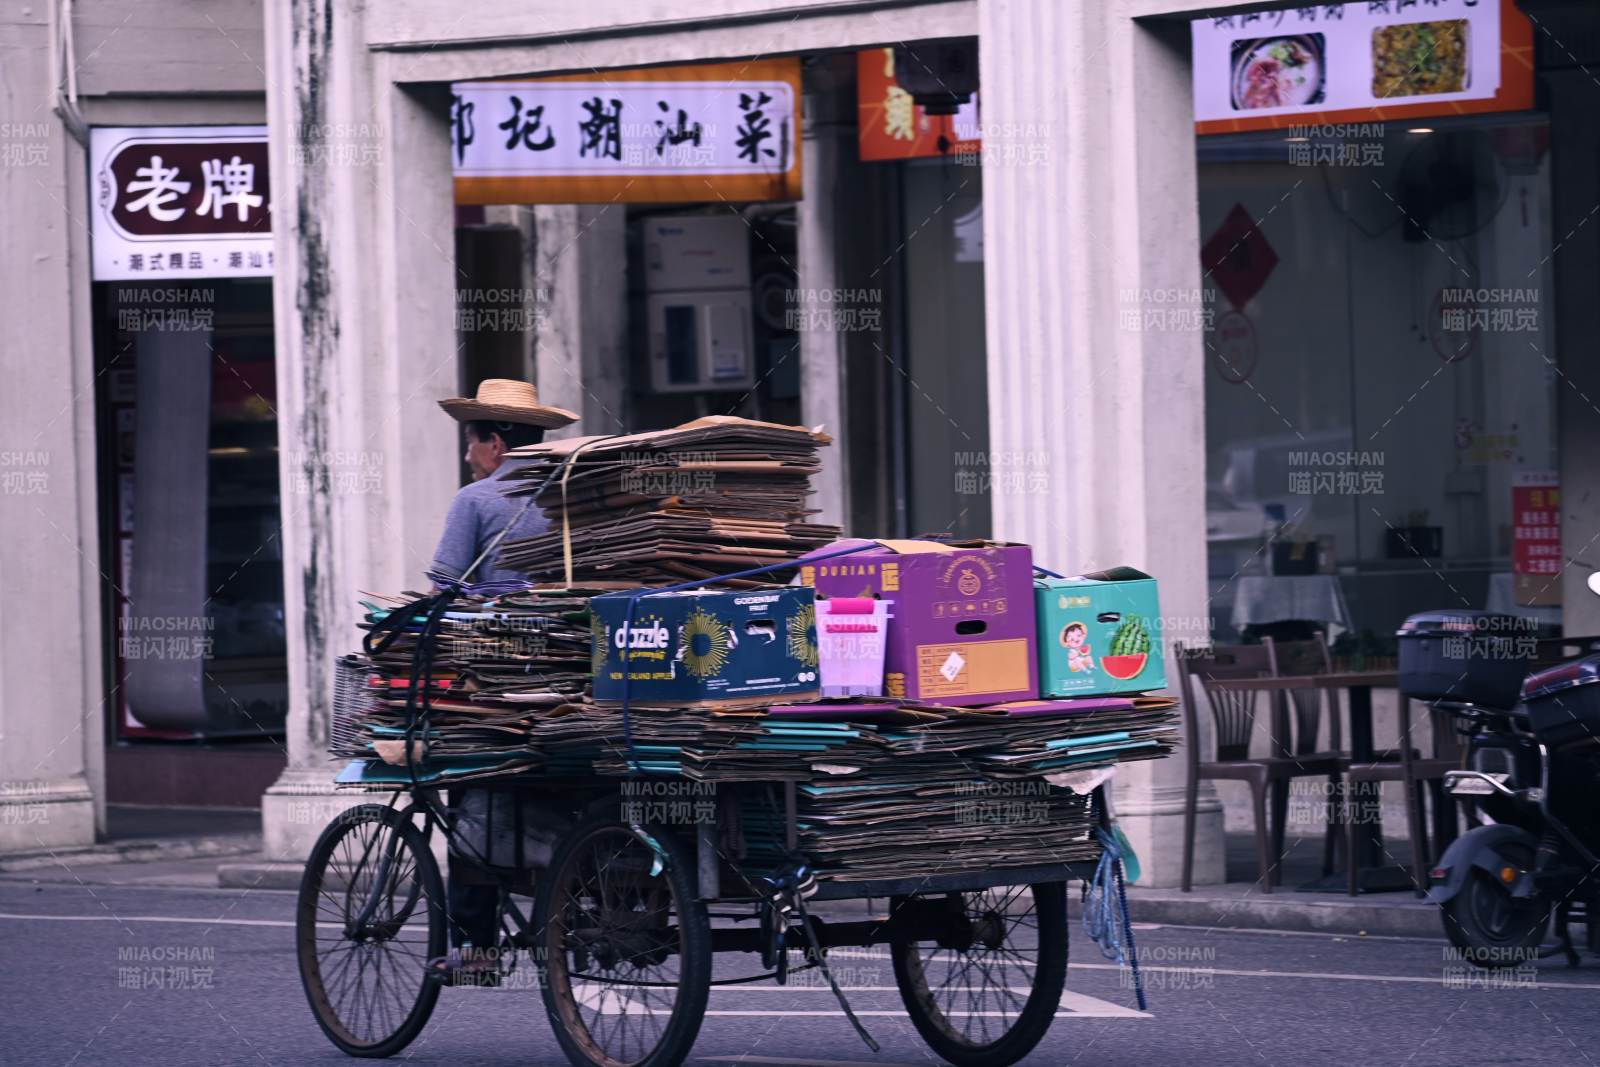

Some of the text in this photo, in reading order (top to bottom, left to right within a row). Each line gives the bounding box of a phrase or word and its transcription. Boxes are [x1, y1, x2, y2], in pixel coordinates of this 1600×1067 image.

[124, 155, 271, 223] 老牌
[820, 563, 876, 578] DURIAN
[614, 620, 670, 649] dazzle
